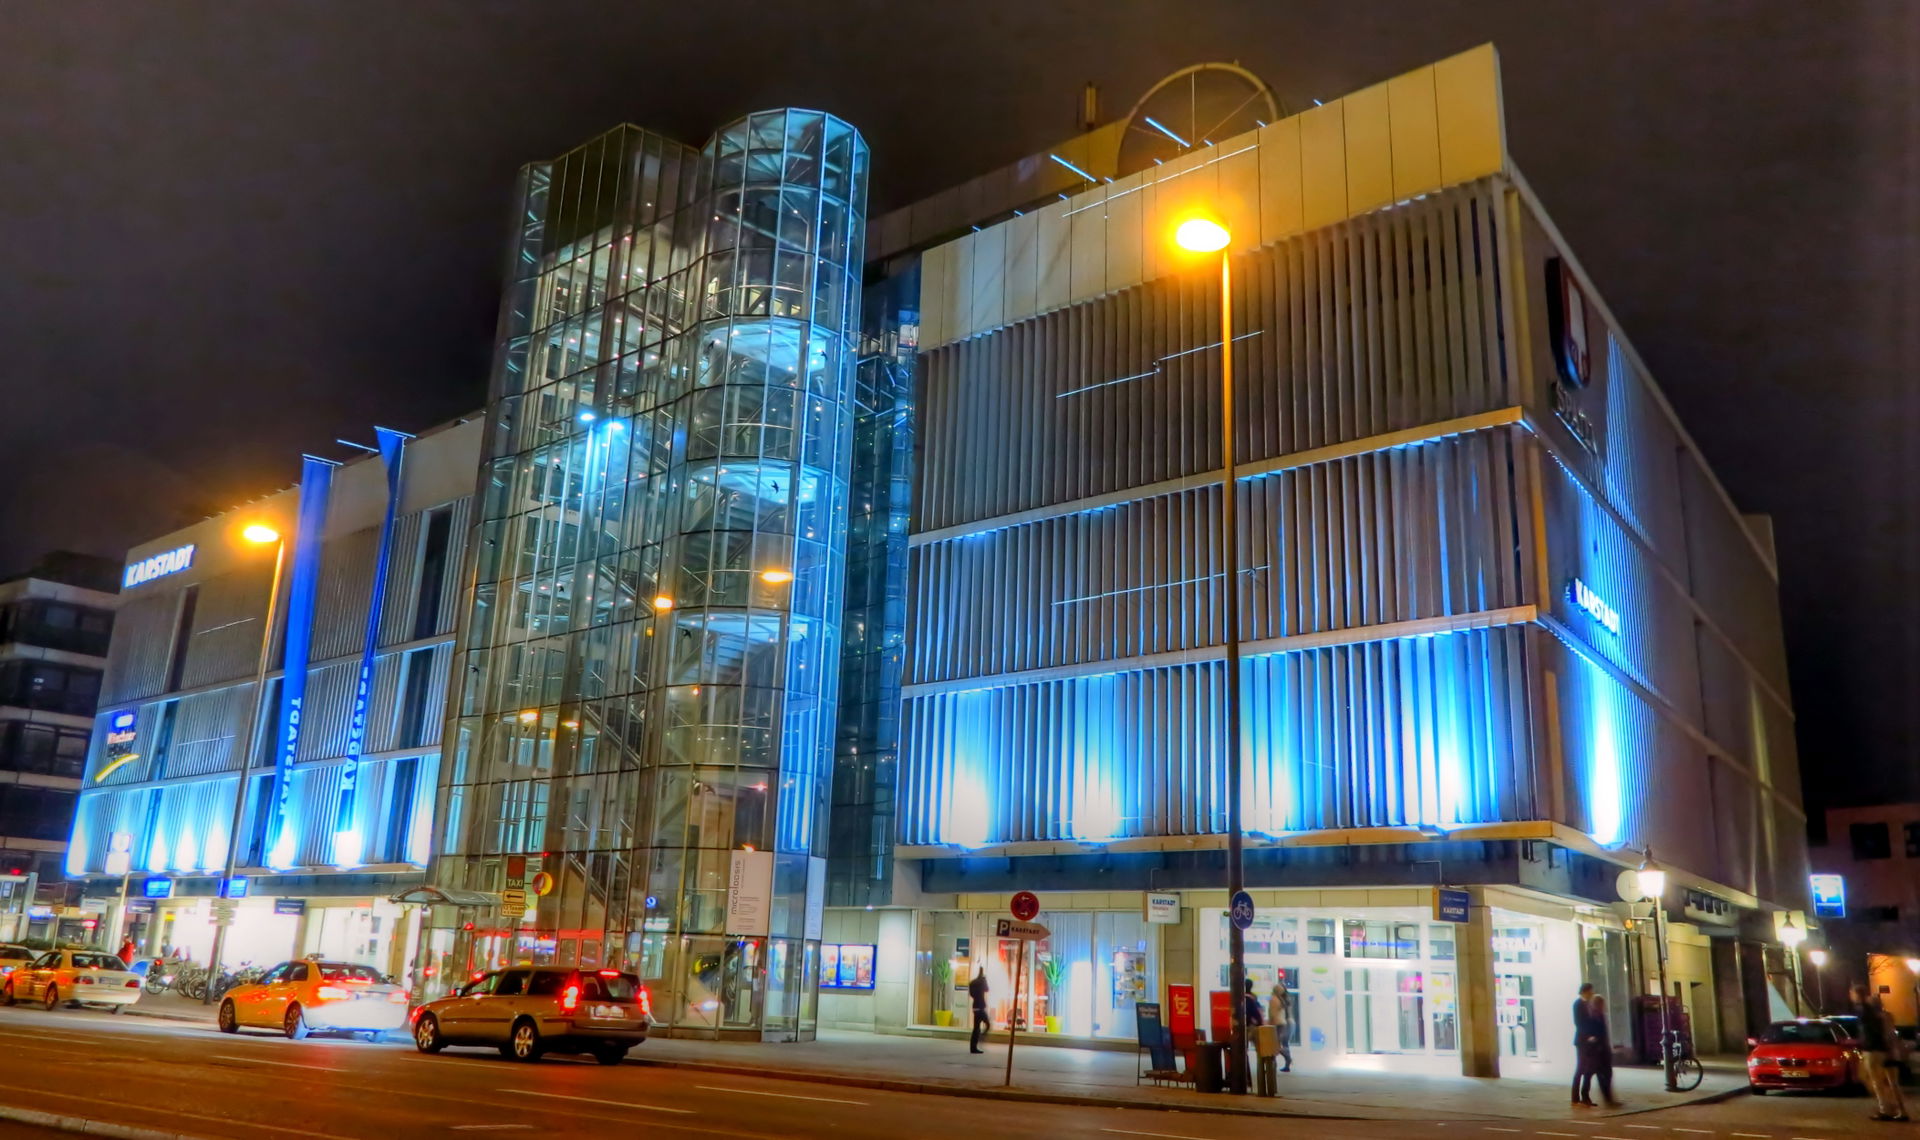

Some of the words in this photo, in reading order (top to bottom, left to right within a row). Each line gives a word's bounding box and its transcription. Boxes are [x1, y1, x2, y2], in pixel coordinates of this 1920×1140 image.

[124, 544, 195, 588] KARSTADT
[1574, 577, 1621, 637] KARSTADT
[508, 878, 523, 888] TAXI
[1000, 921, 1009, 934] P
